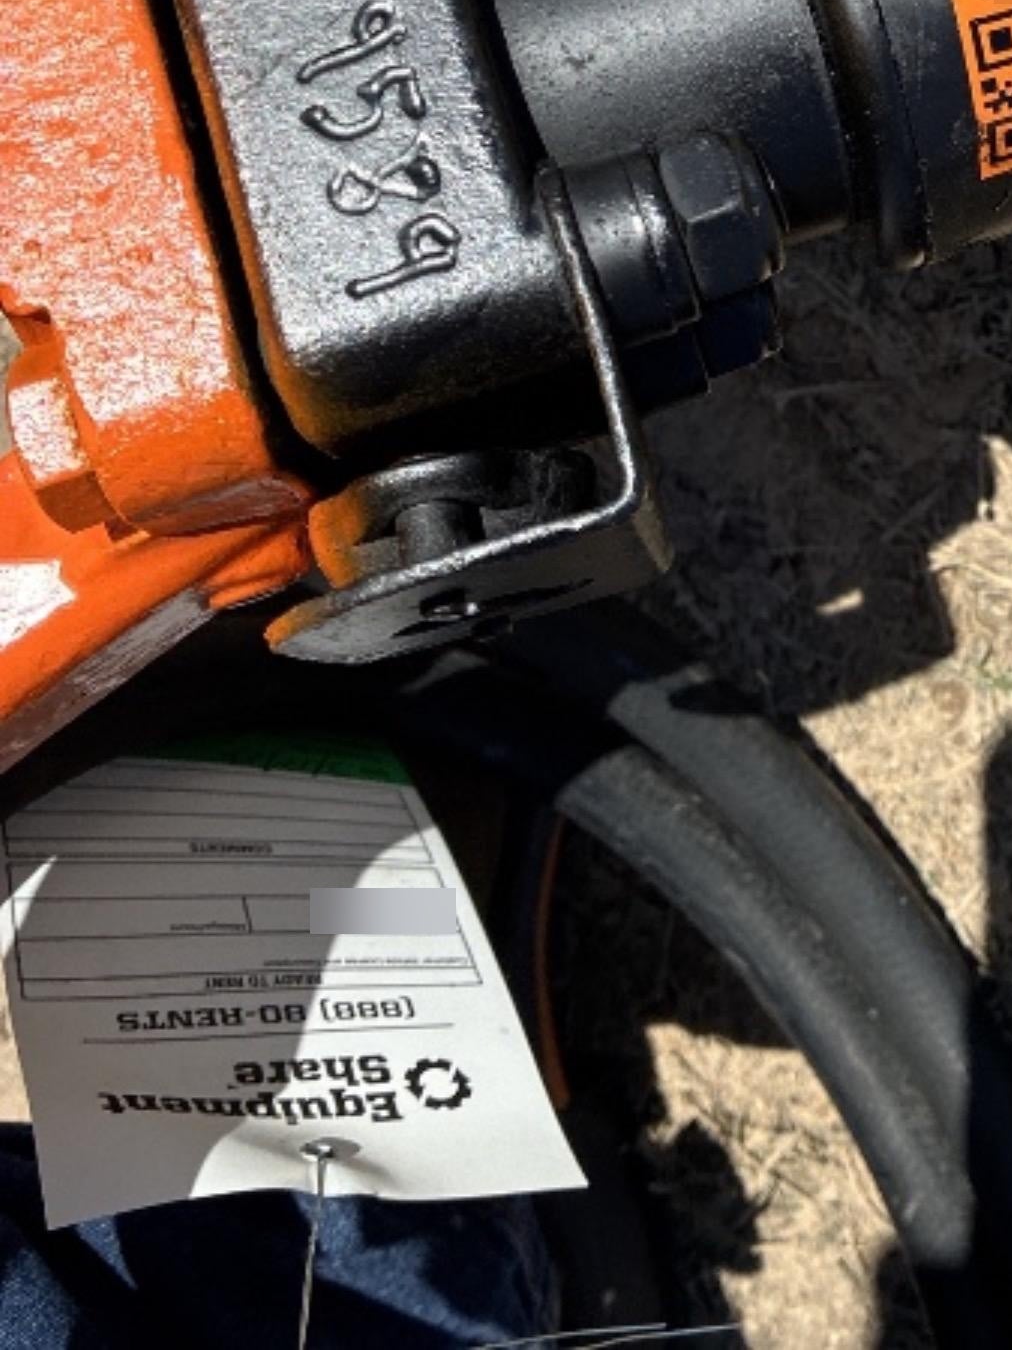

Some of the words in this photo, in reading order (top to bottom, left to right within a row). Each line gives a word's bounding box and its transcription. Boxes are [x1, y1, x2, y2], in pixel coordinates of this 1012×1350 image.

[116, 1002, 307, 1033] 80-RENTS
[320, 995, 416, 1021] (888)
[232, 1054, 392, 1086] Share
[100, 1091, 404, 1125] Equipment
